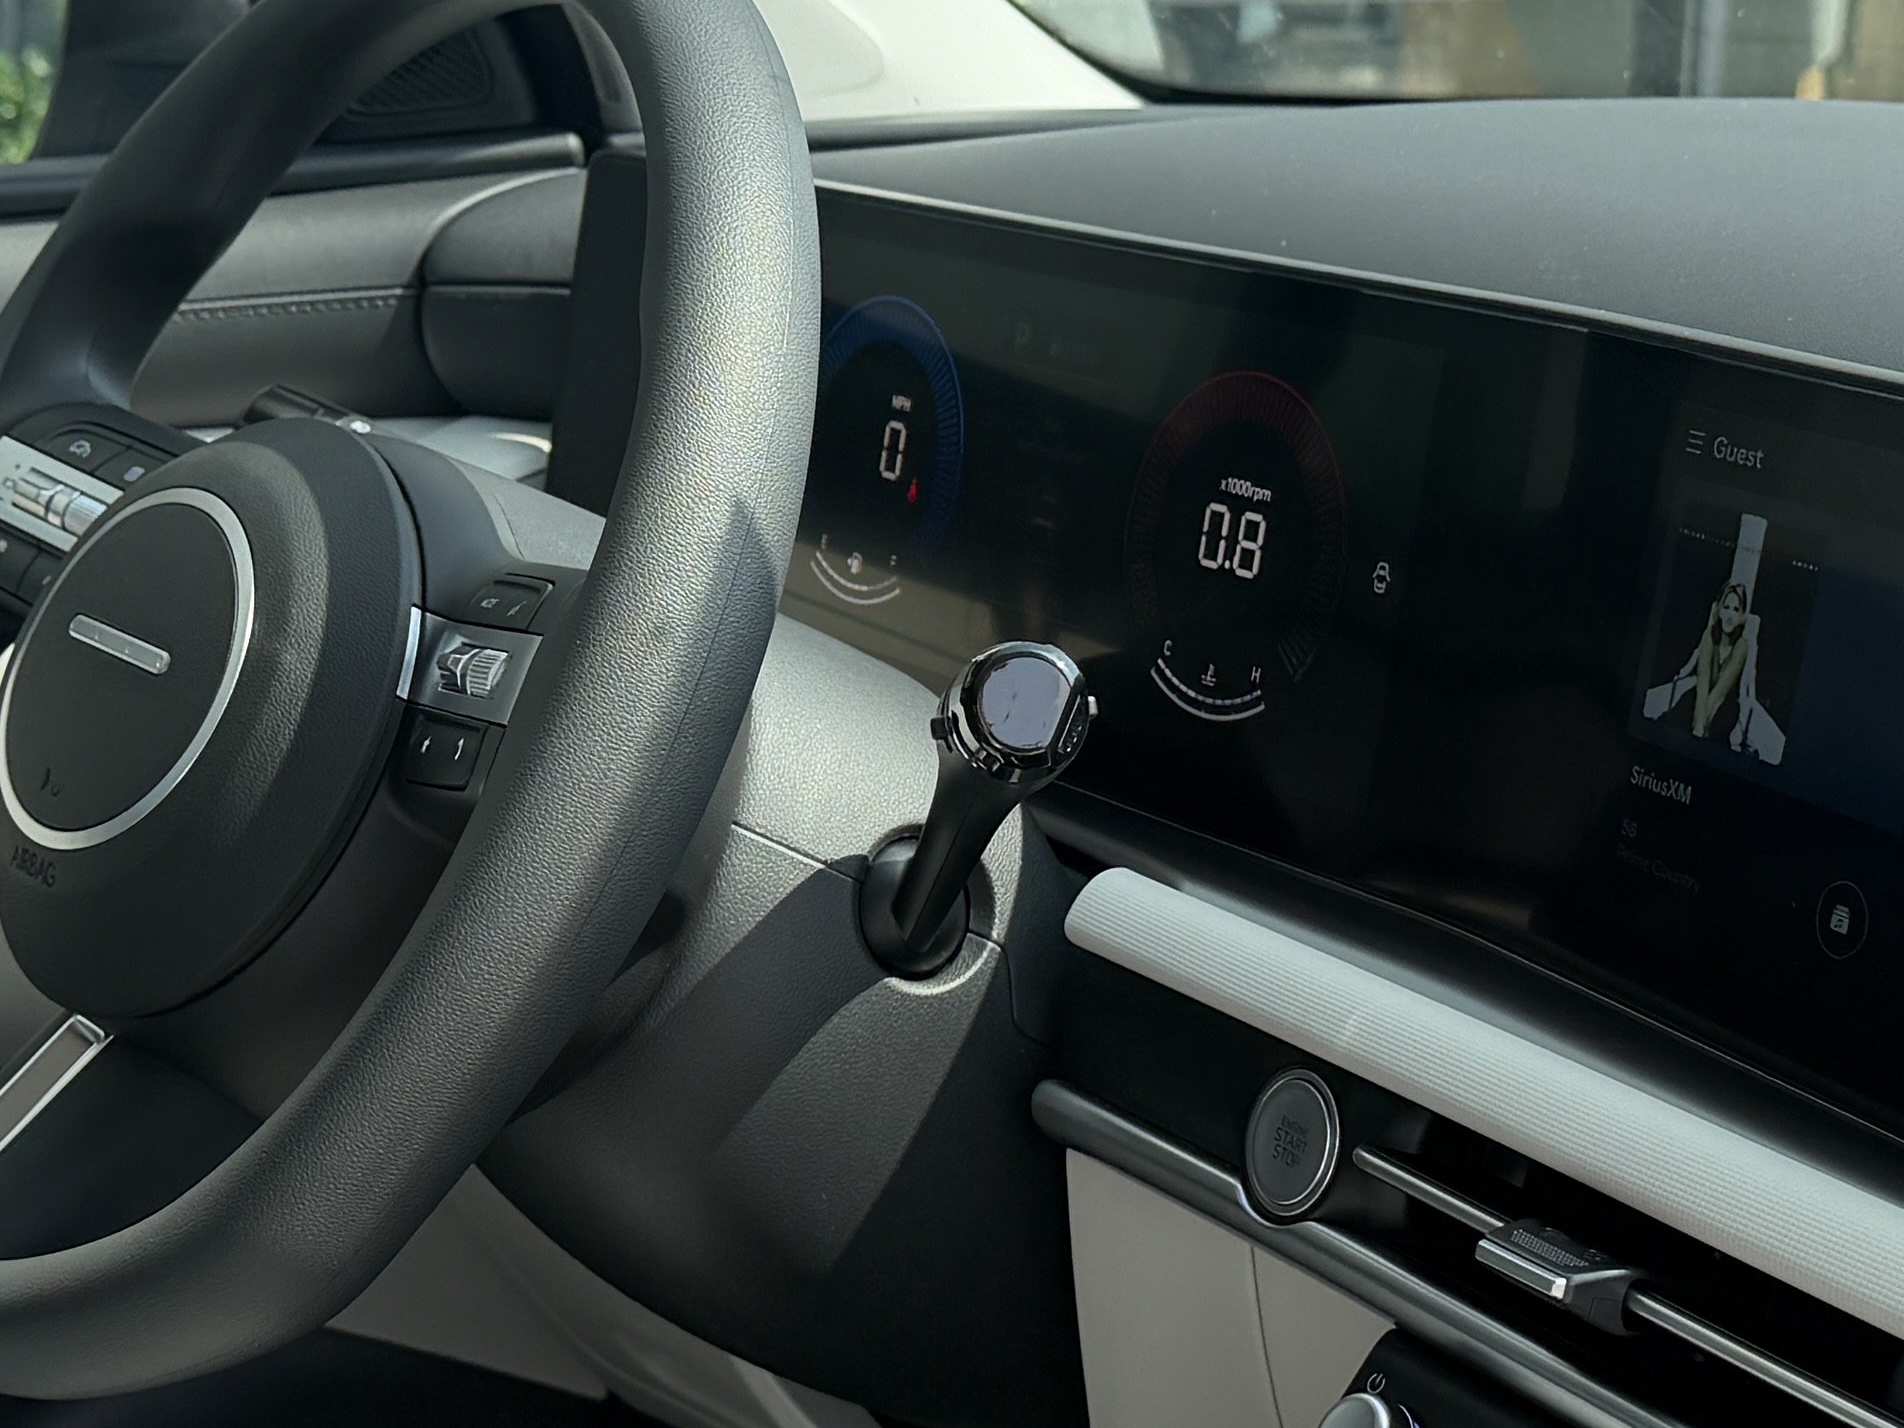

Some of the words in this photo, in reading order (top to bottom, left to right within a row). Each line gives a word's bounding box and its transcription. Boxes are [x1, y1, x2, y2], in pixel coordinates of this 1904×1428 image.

[879, 419, 907, 482] 0
[1713, 436, 1764, 469] Guest
[1198, 501, 1266, 581] 0.8
[1162, 639, 1174, 659] C
[1251, 666, 1263, 687] H
[1630, 765, 1693, 806] SiriusXM
